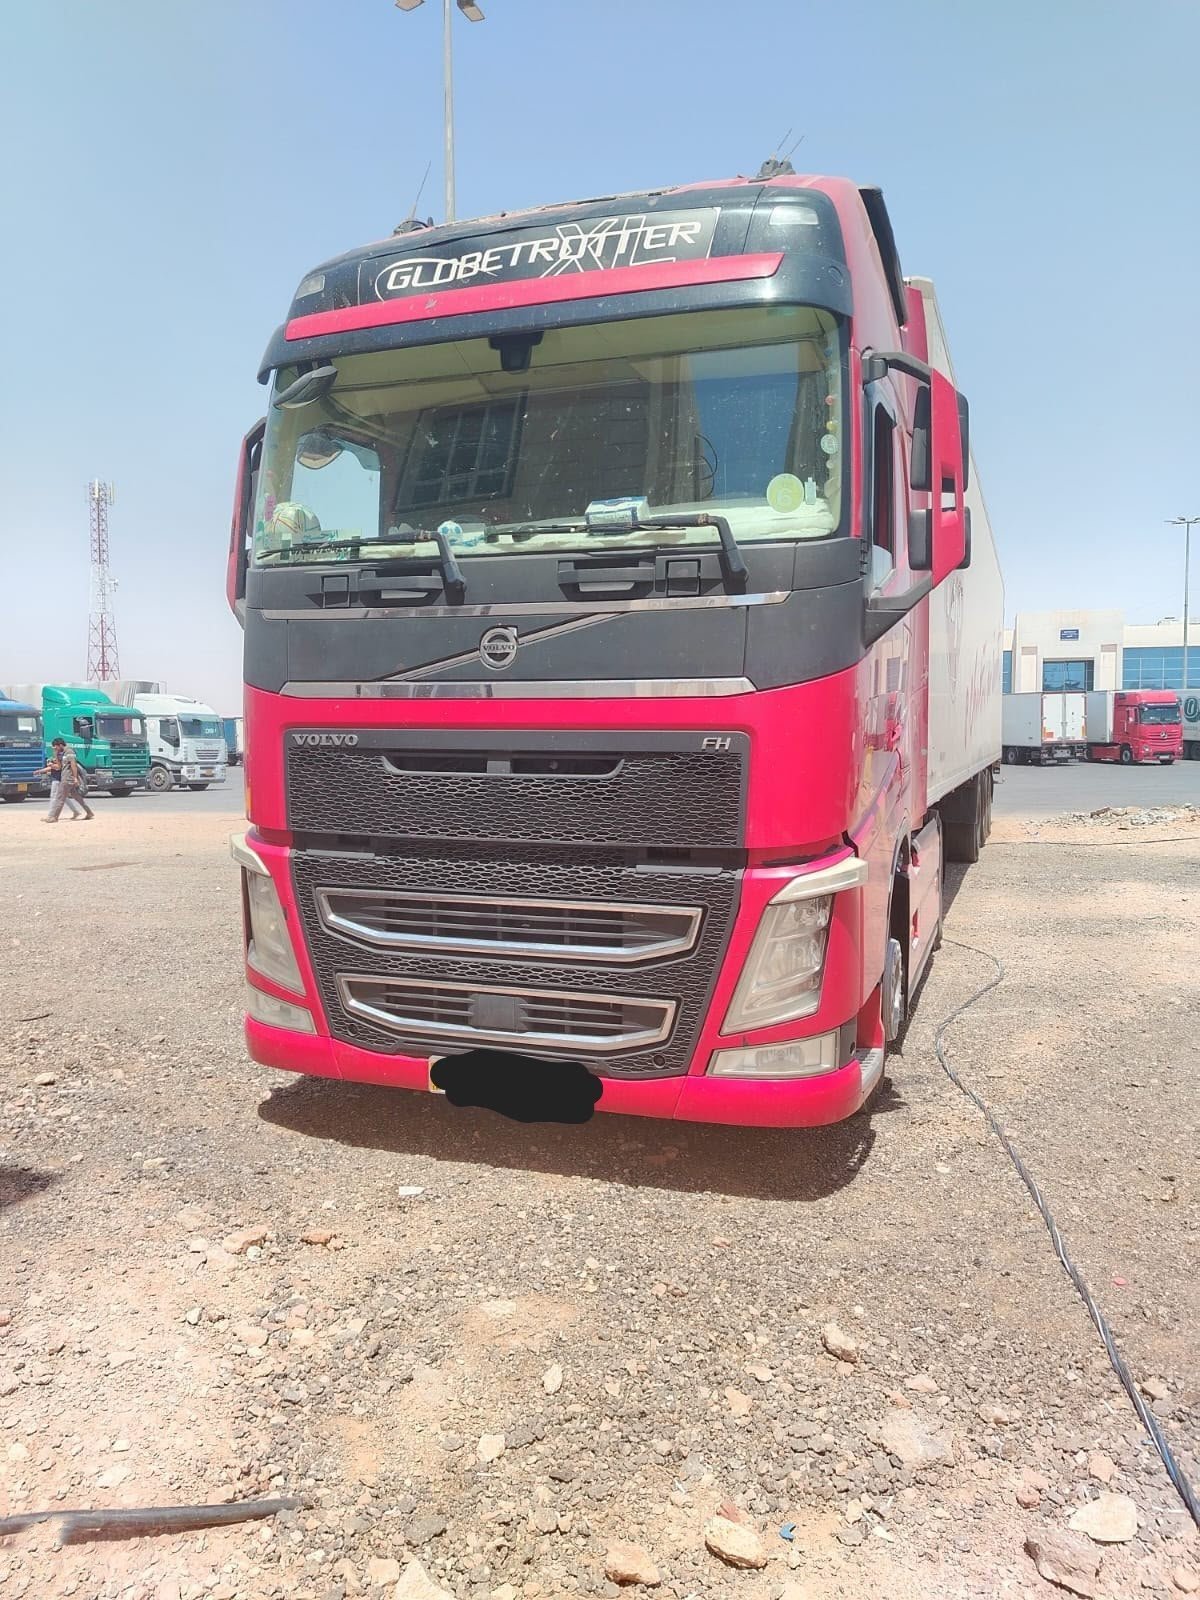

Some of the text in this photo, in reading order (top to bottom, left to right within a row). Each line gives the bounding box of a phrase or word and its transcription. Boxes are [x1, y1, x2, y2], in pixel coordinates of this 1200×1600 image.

[386, 221, 702, 290] GLOBETROTTER
[483, 643, 515, 651] VOLVO
[291, 733, 359, 746] VOLVO
[701, 737, 731, 750] FH
